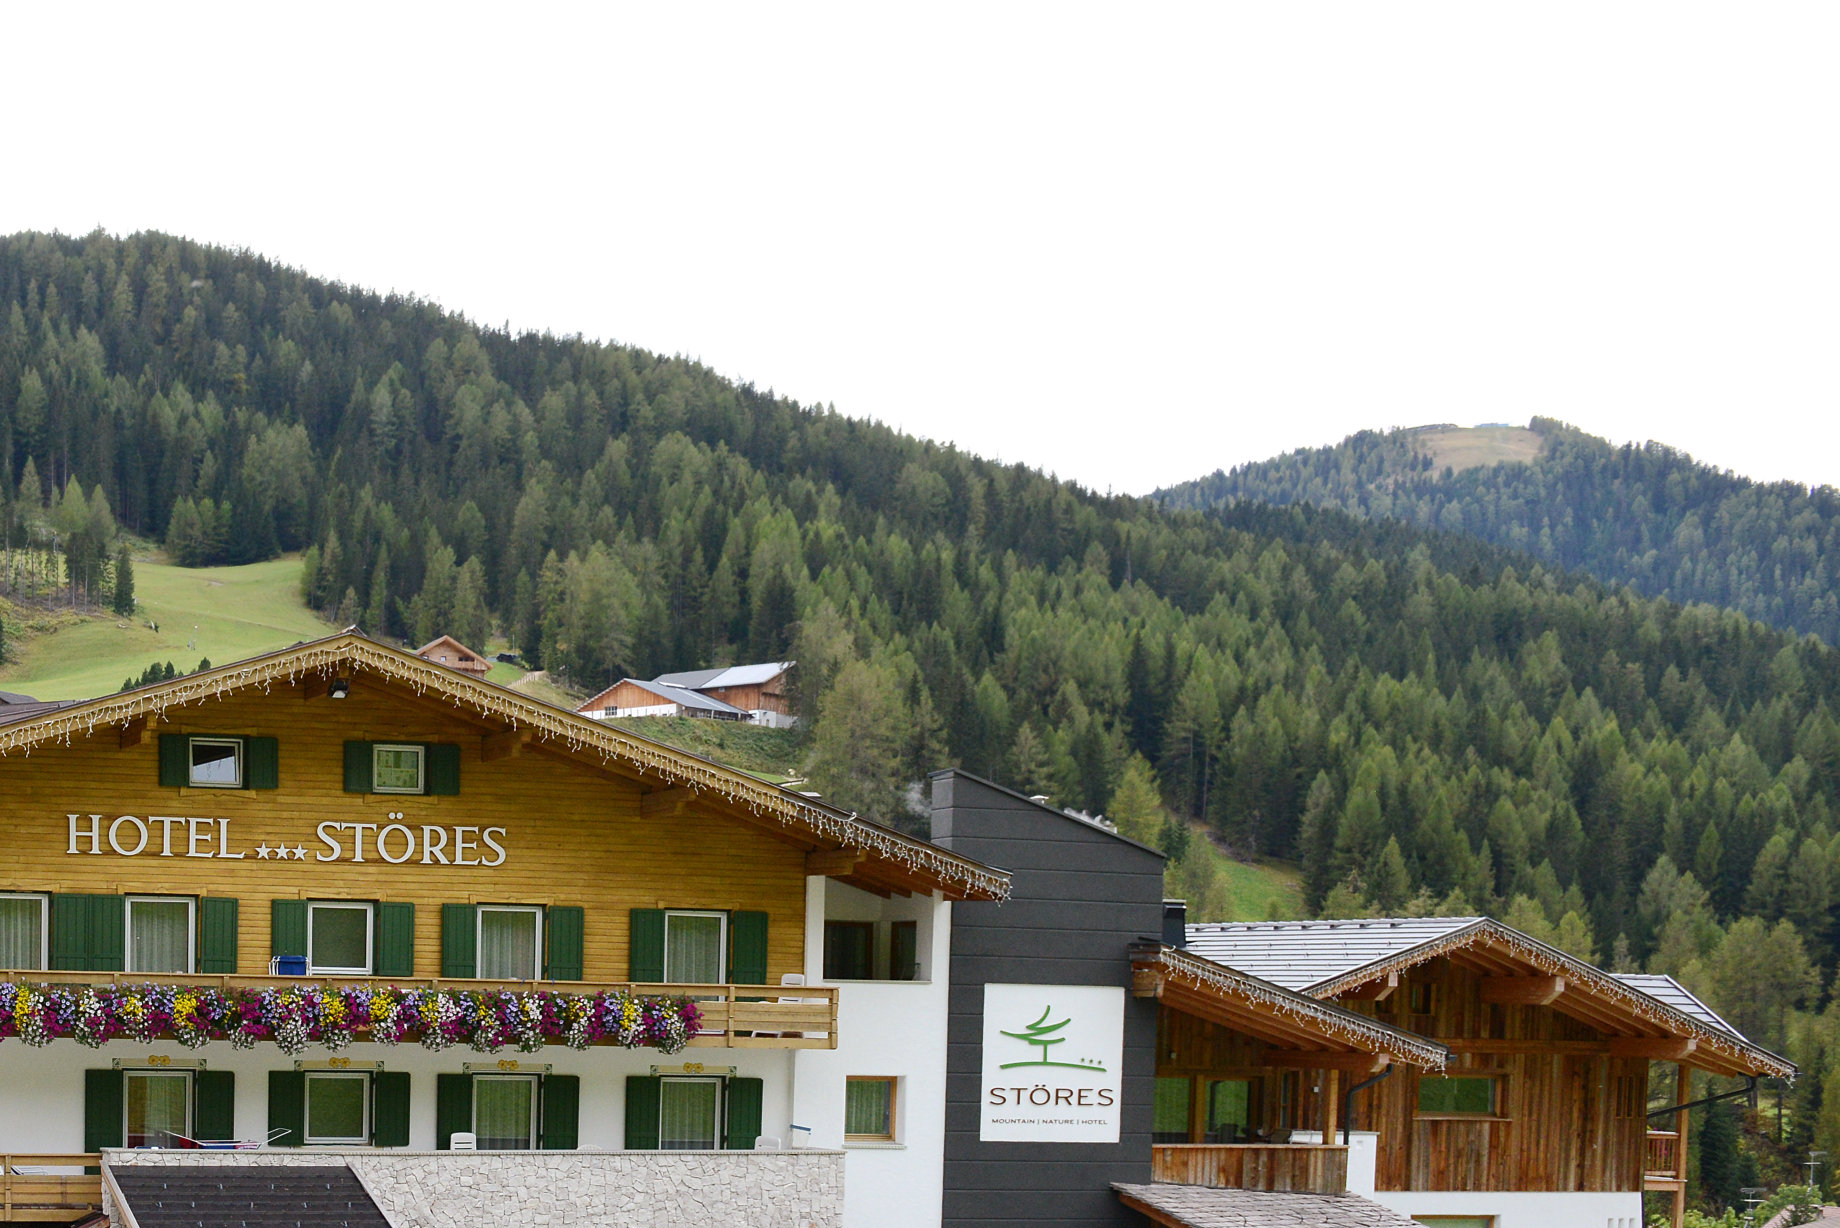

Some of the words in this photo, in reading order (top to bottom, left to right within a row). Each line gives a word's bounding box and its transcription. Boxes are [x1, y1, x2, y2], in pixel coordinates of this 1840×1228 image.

[66, 813, 246, 859] HOTEL
[316, 812, 507, 867] STÖRES
[989, 1084, 1114, 1107] STÖRES
